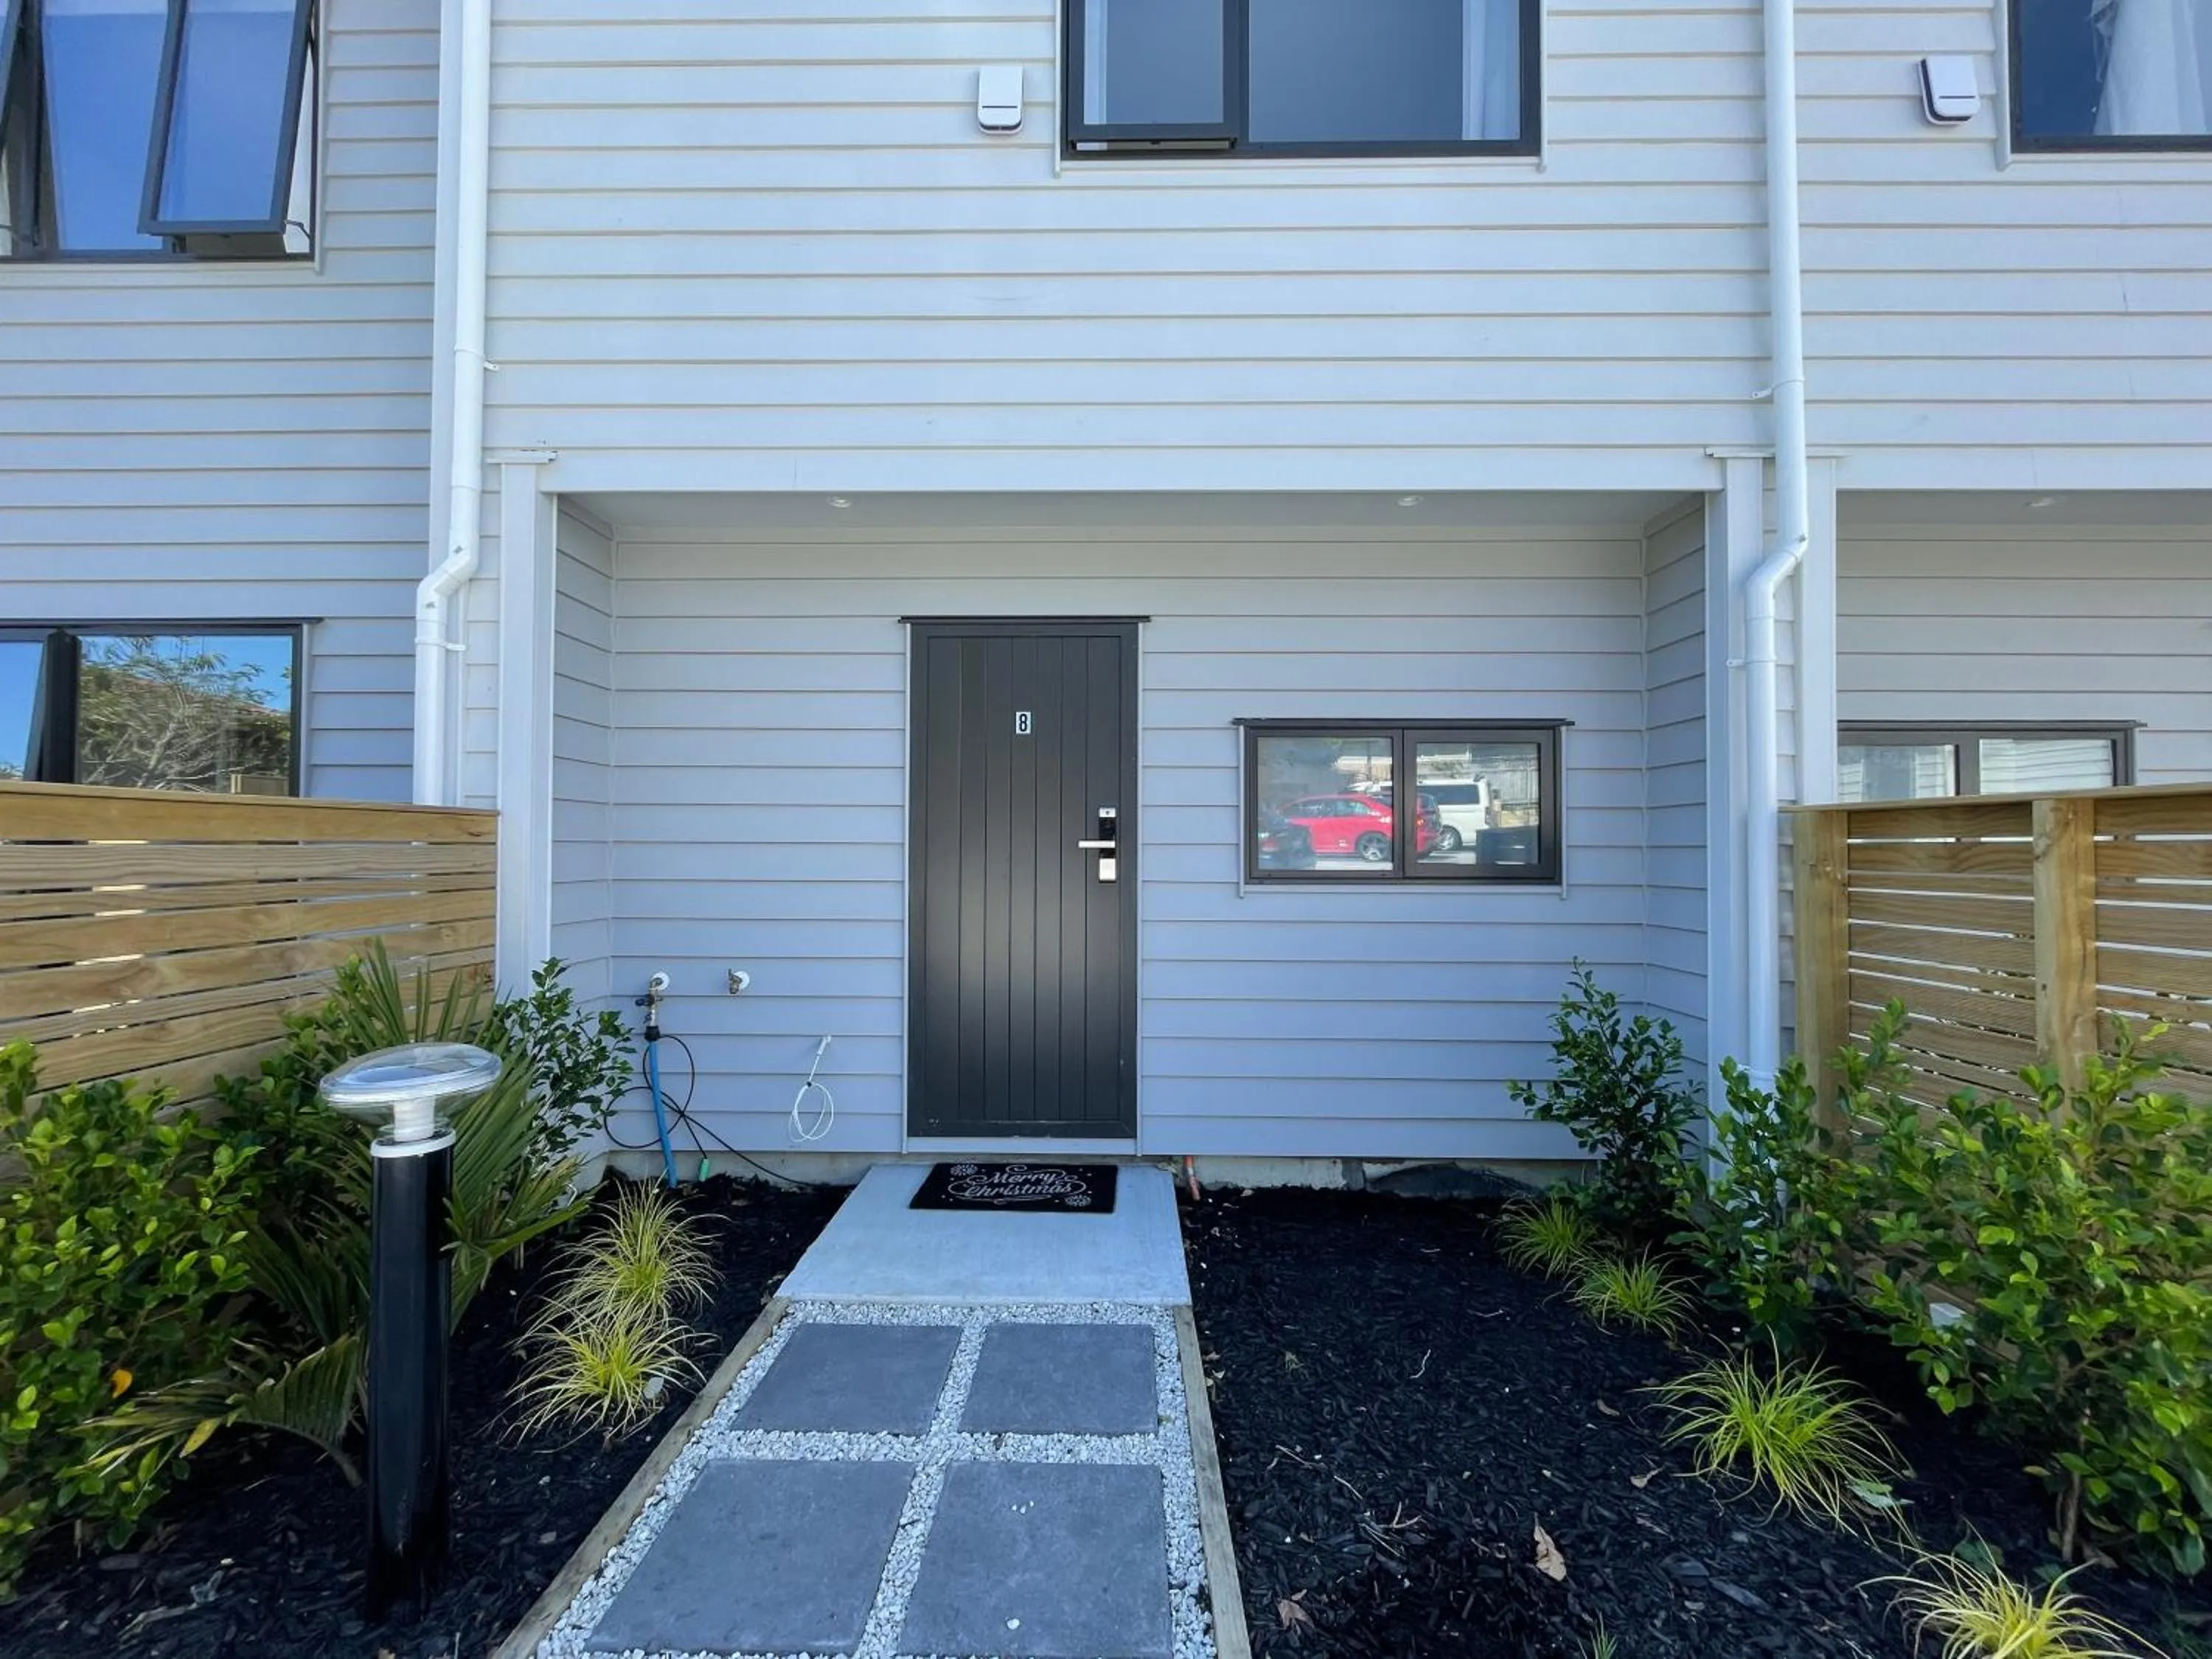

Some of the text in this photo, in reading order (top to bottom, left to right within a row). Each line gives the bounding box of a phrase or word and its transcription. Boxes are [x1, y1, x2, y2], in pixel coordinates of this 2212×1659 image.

[1019, 713, 1028, 732] 8
[984, 1168, 1062, 1185] Merry
[964, 1181, 1074, 1197] Christmas
